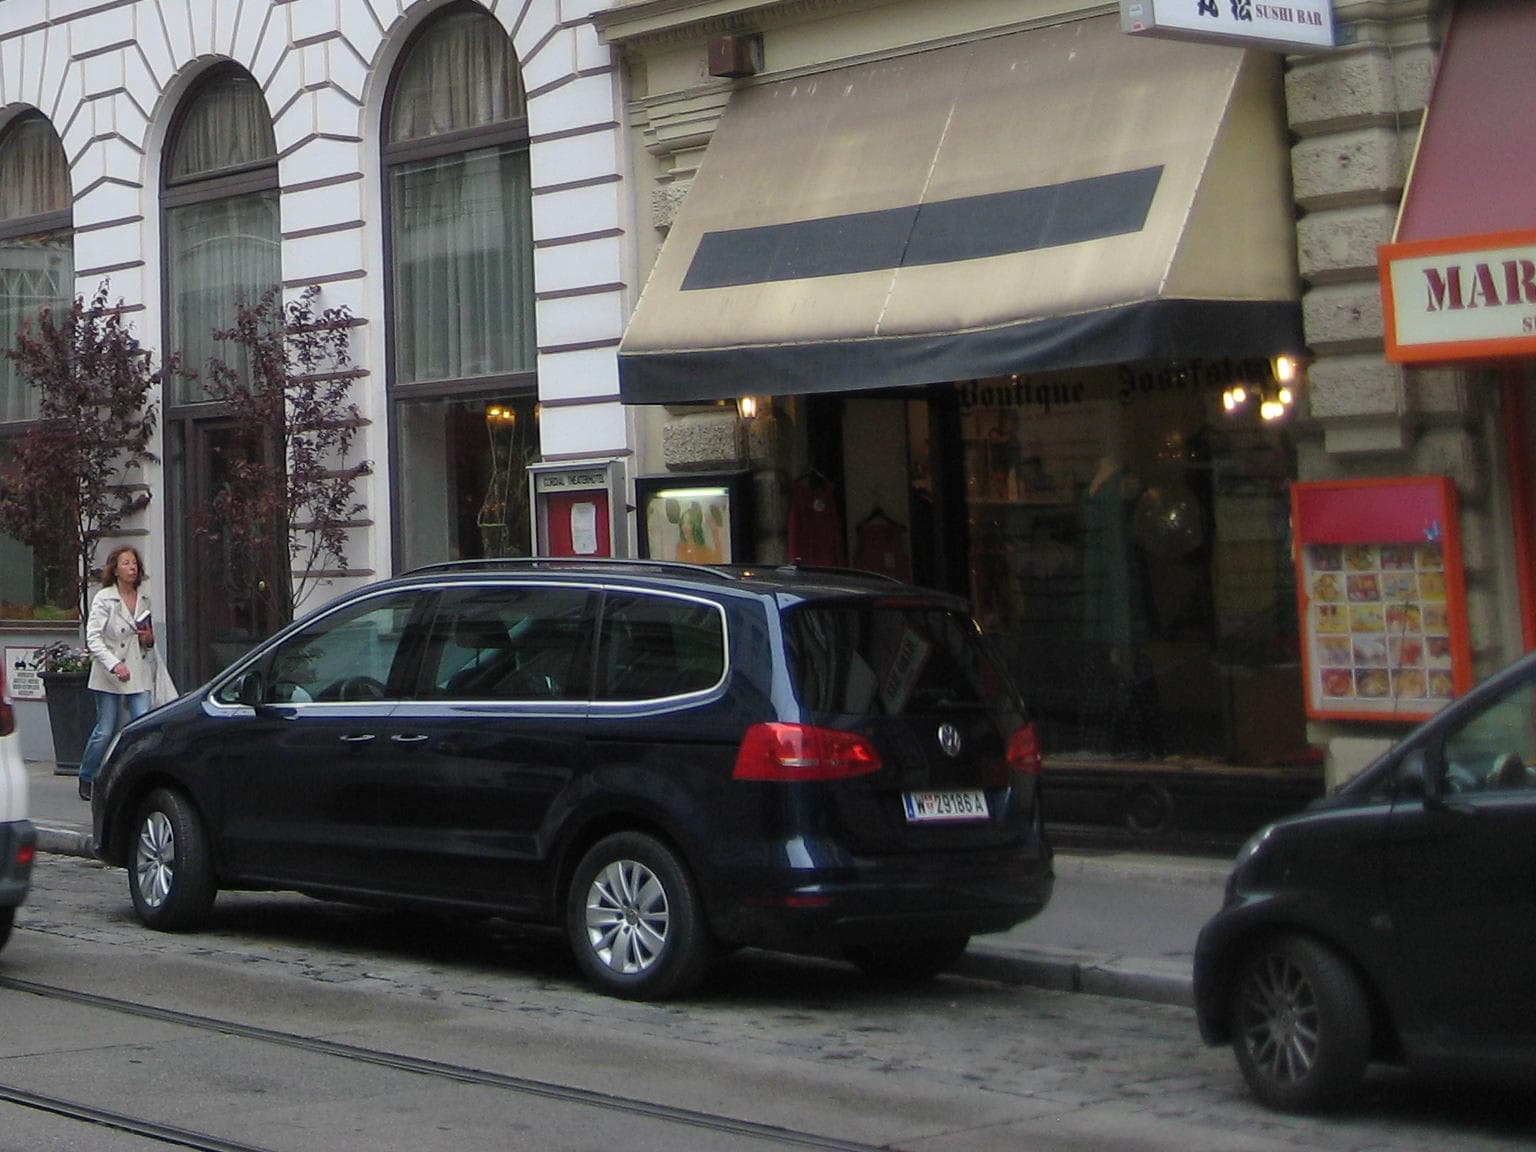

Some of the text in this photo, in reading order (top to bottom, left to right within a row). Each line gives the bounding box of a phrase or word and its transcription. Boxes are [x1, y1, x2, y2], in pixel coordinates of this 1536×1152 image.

[1255, 4, 1323, 26] SUSHI BAR
[917, 796, 927, 814] W
